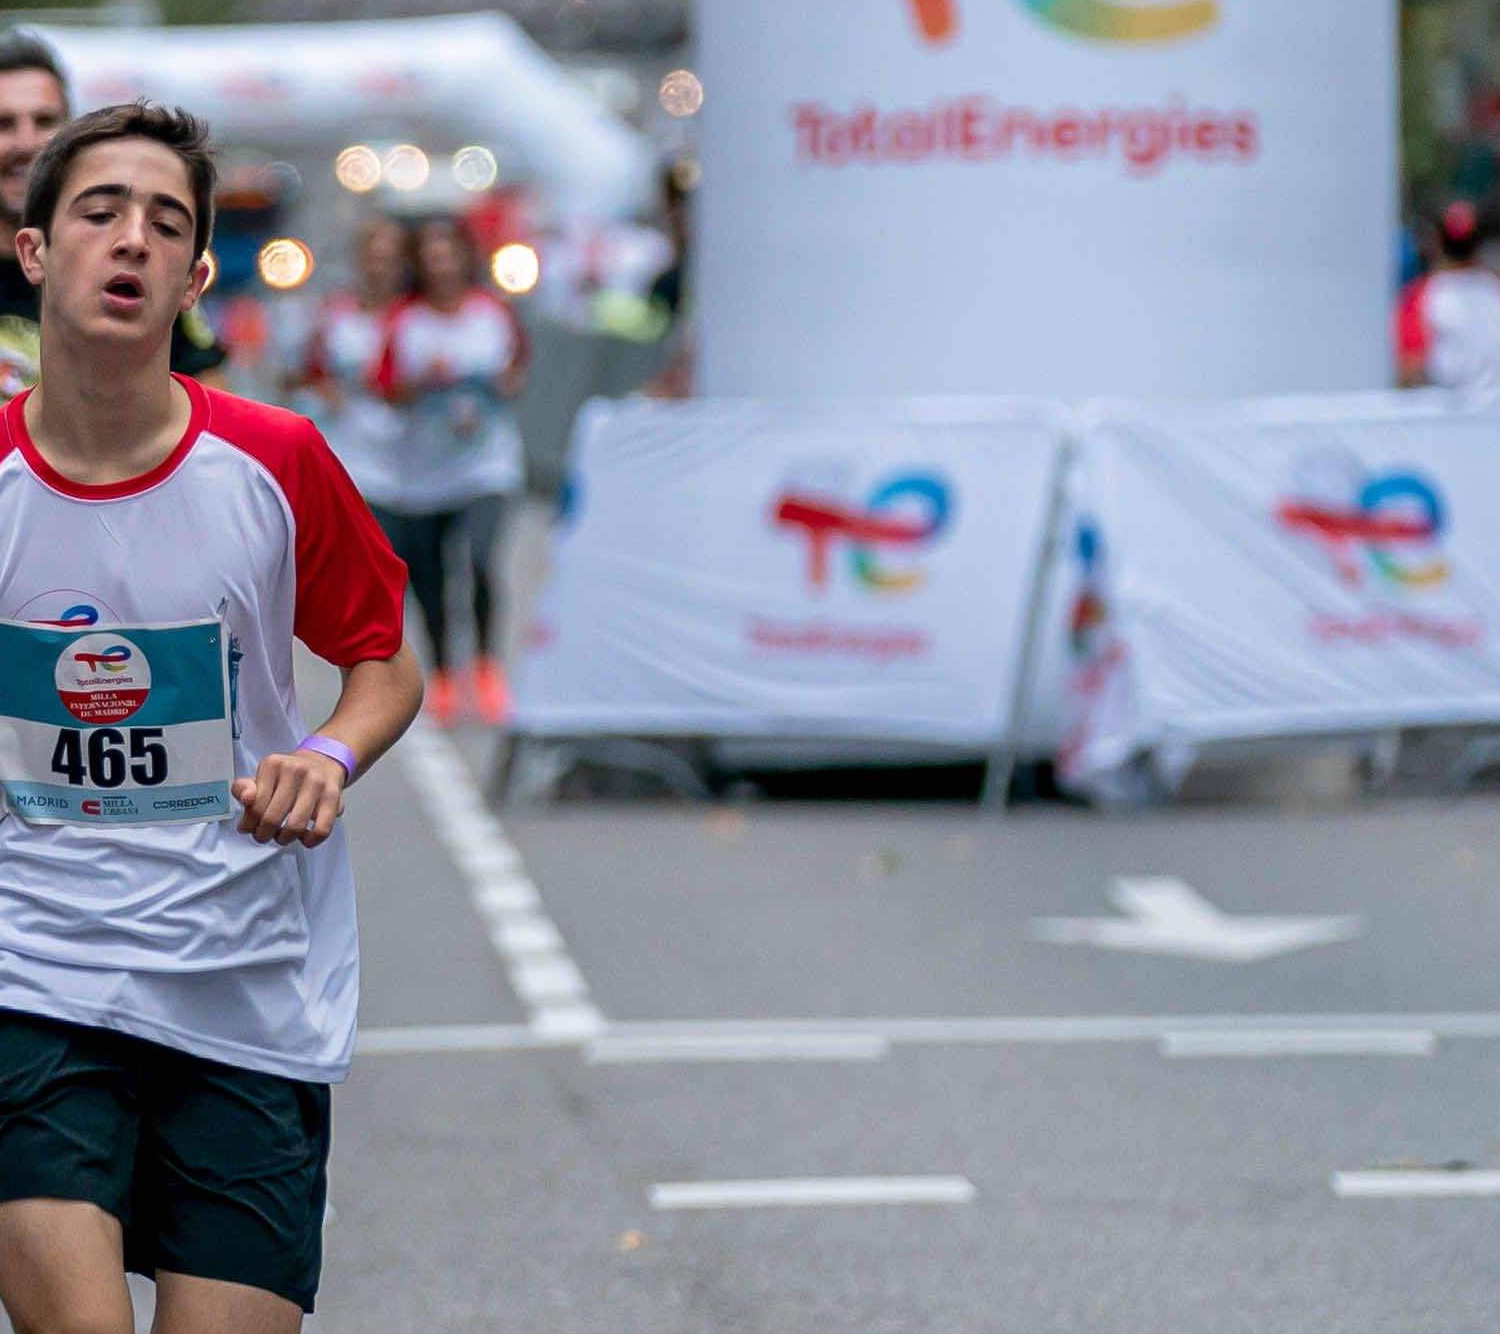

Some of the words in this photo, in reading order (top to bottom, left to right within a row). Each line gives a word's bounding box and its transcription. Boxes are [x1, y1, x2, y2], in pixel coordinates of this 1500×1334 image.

[792, 95, 1260, 172] TotalEnergies
[76, 676, 134, 686] TotalEnergies
[90, 693, 118, 701] MILLA
[70, 700, 137, 710] INTERNACIONAL
[81, 710, 93, 718] DE
[94, 708, 129, 717] MADRID
[51, 728, 168, 788] 465
[16, 794, 69, 809] MADRID
[103, 798, 134, 807] MILLA
